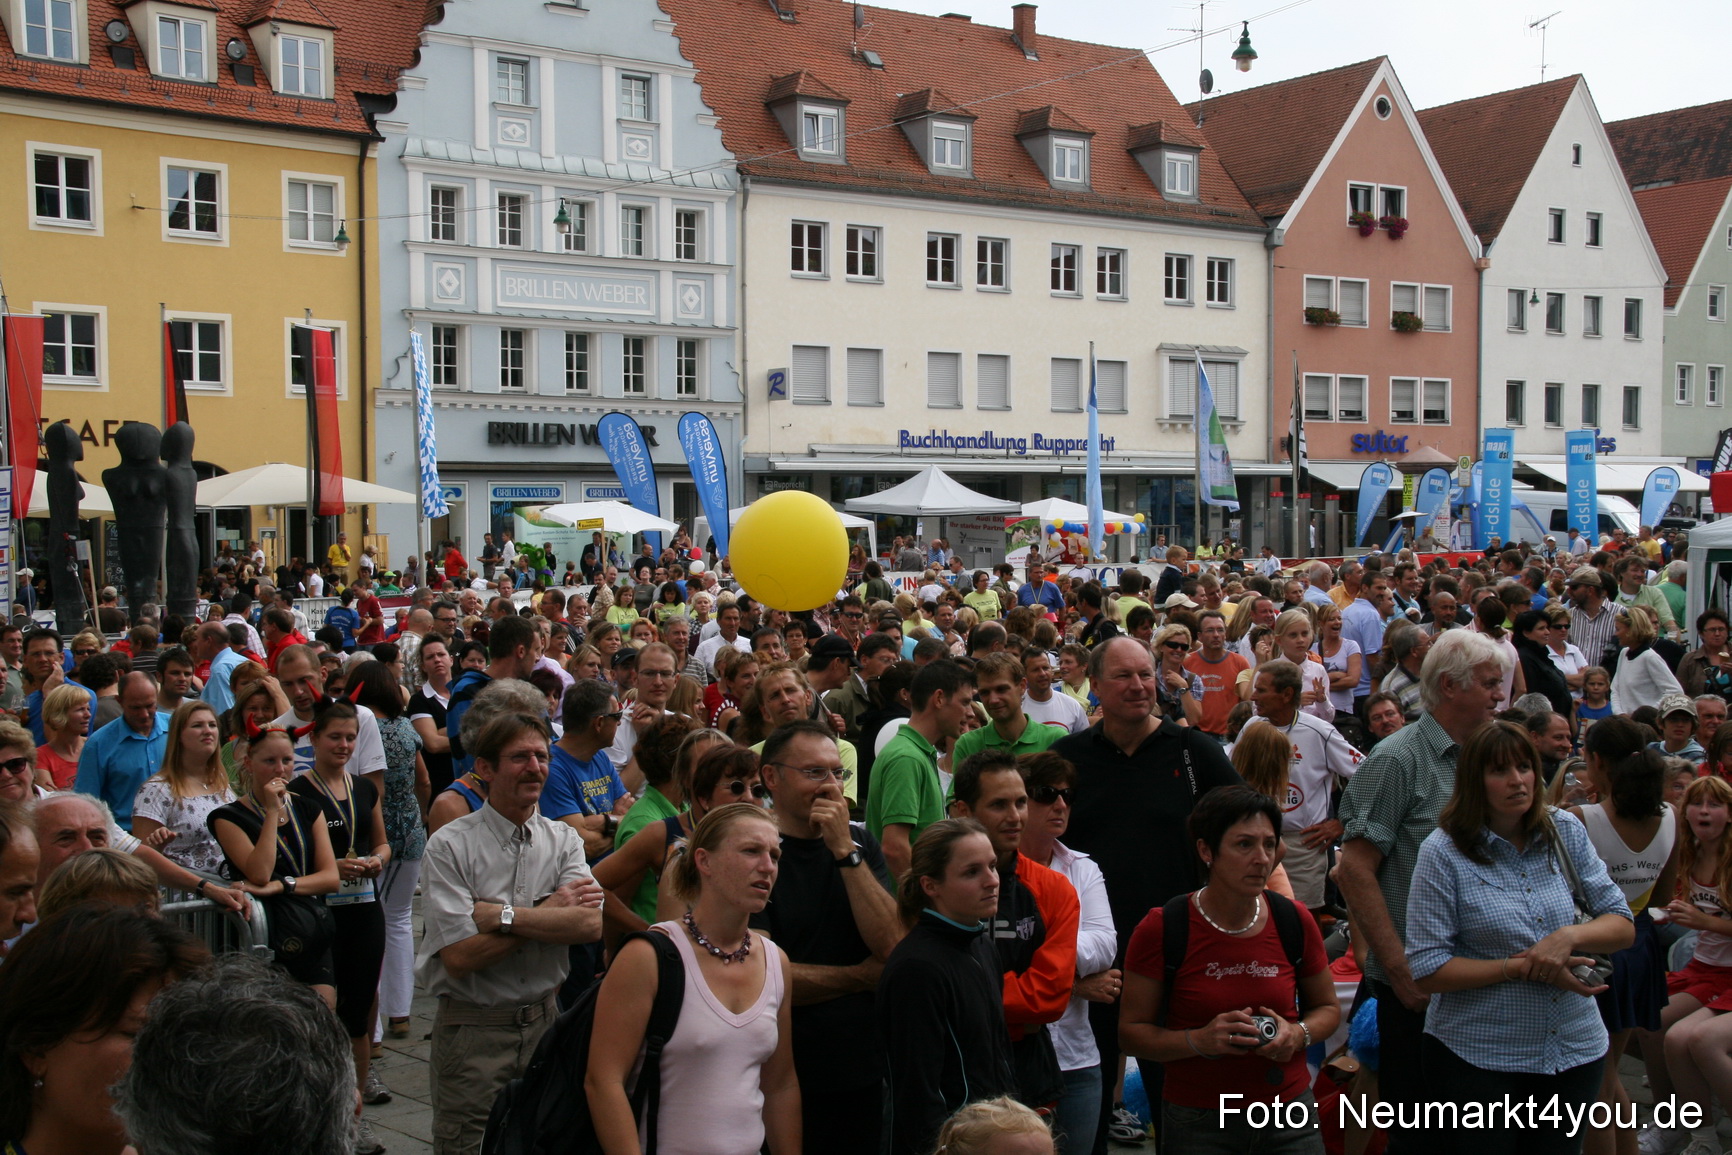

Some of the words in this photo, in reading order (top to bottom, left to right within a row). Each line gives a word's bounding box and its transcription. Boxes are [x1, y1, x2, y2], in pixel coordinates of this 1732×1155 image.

[505, 277, 578, 300] BRILLEN
[581, 282, 647, 305] WEBER
[769, 372, 785, 396] R
[487, 421, 576, 447] BRILLEN
[898, 429, 1027, 455] Buchhandlung
[1031, 432, 1115, 456] Ruppreht
[1486, 440, 1508, 451] maxi
[1571, 443, 1591, 454] maxi
[1498, 451, 1509, 459] dsl
[1585, 453, 1594, 461] dsl
[496, 488, 528, 497] BRILLEN
[529, 488, 558, 497] WEBER
[589, 488, 619, 497] BRILLEN
[960, 522, 981, 530] starker
[1183, 749, 1191, 765] EOS
[1187, 766, 1198, 796] DIGITAL
[1611, 862, 1628, 873] HS
[1637, 860, 1660, 871] West
